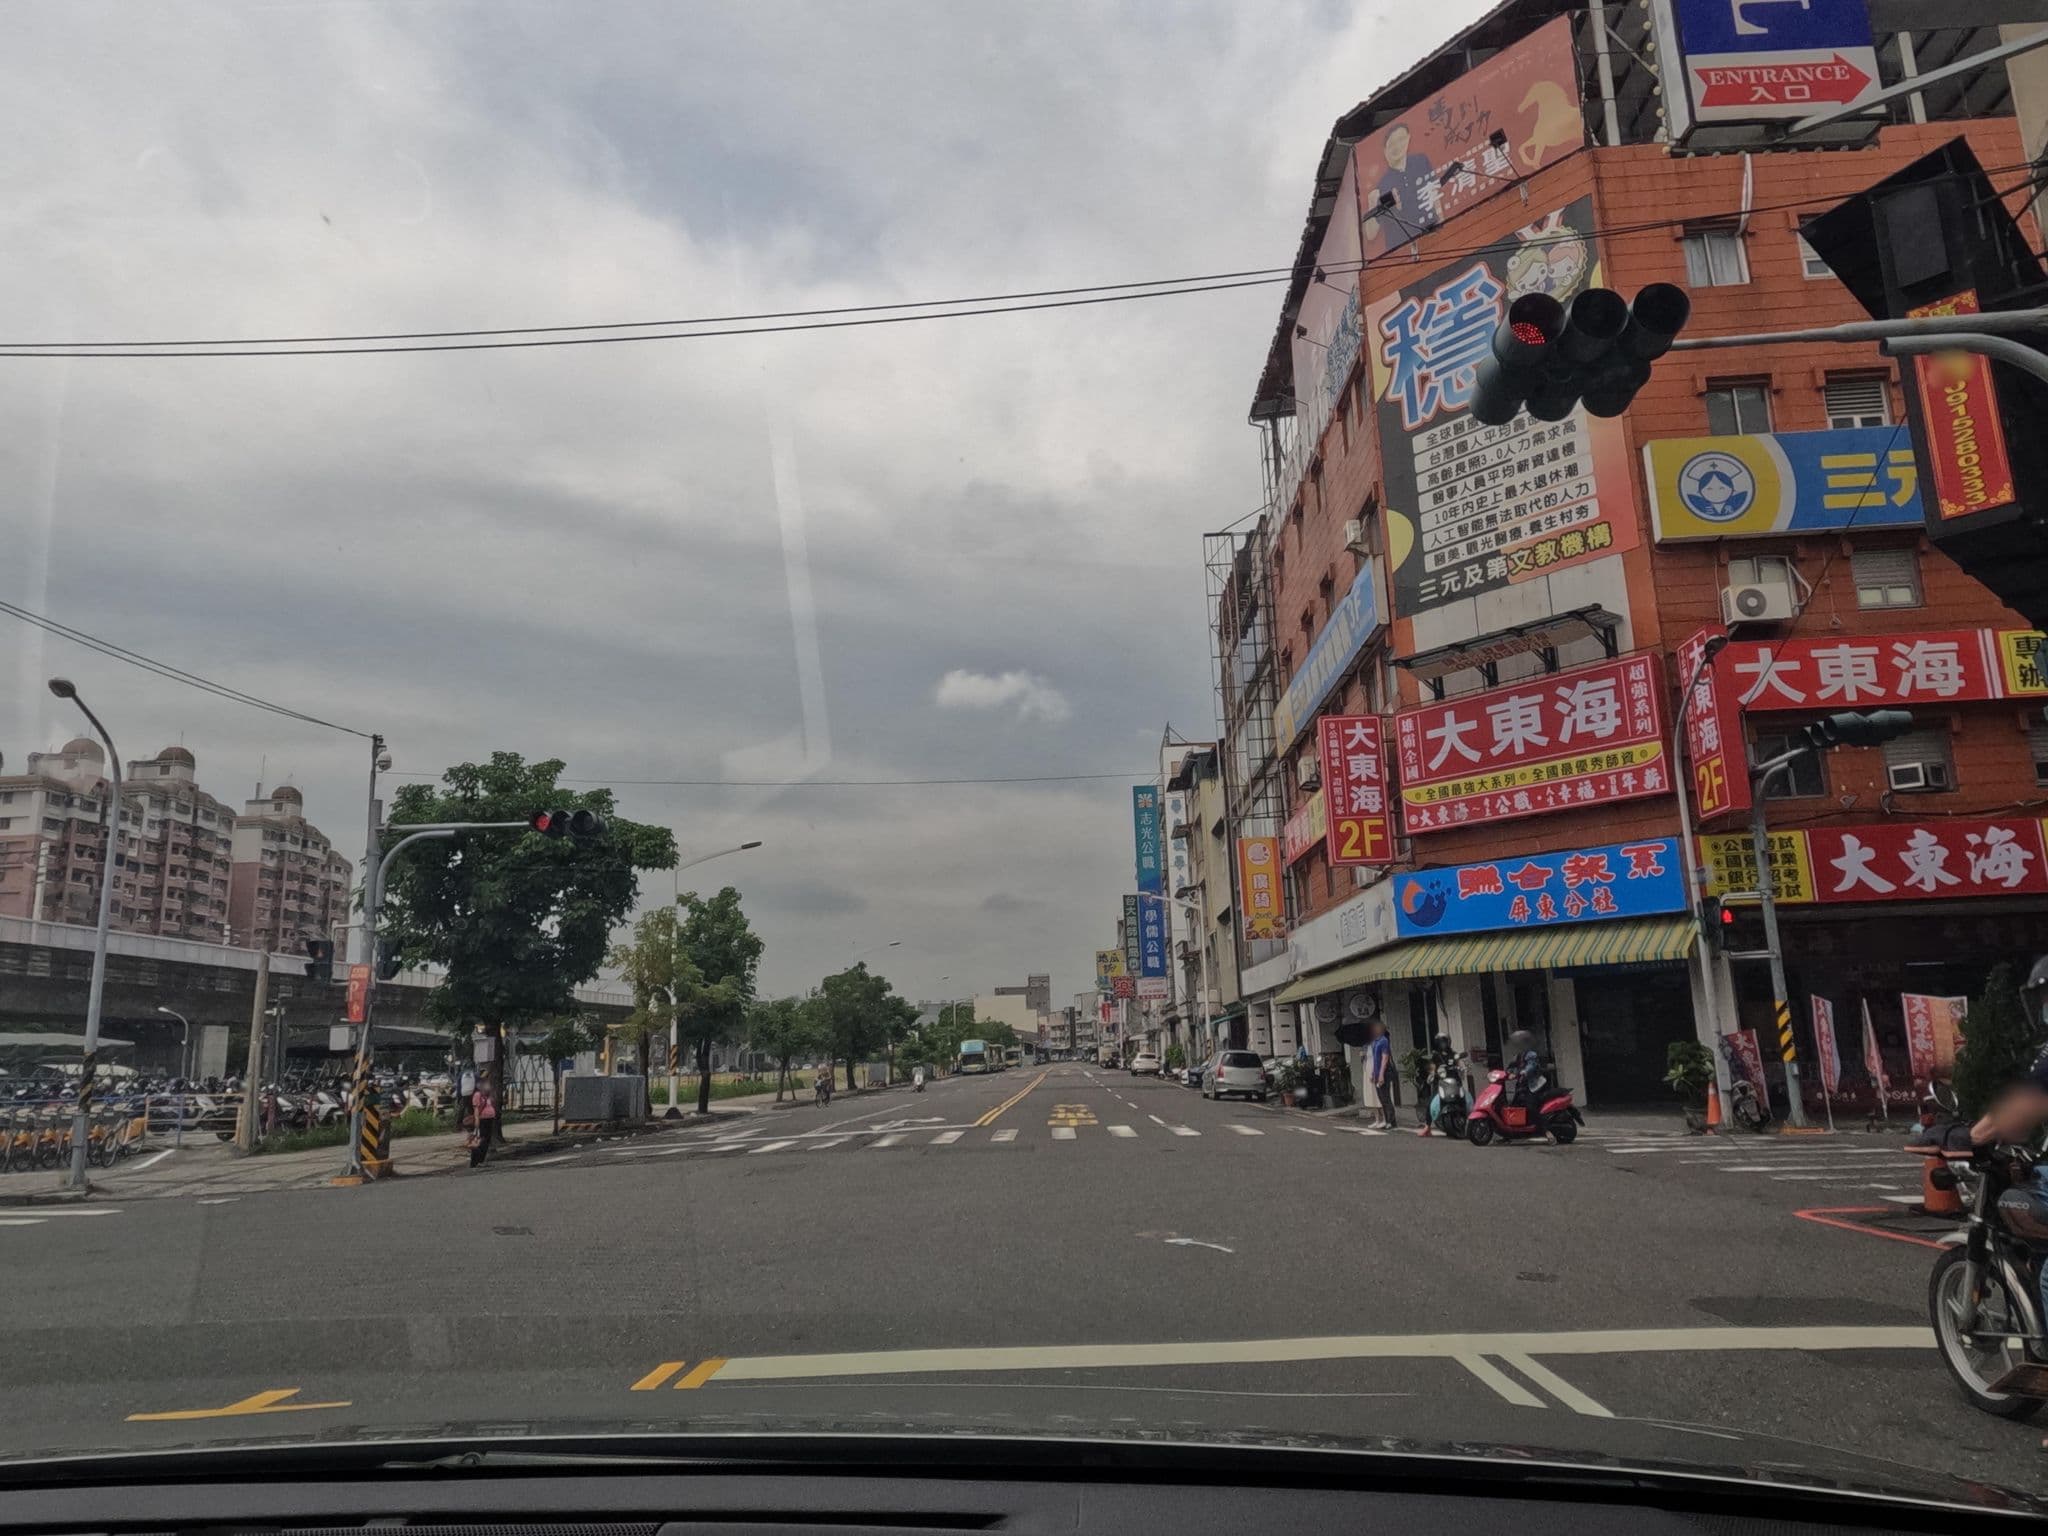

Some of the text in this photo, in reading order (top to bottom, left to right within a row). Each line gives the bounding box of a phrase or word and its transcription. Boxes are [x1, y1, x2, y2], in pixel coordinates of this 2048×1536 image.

[1708, 64, 1850, 86] ENTRANCE
[1749, 85, 1812, 102] 入口
[1380, 263, 1505, 430] 穩
[1431, 481, 1590, 547] 人工智能無法取代的人力
[1629, 664, 1653, 735] 超強系列
[1734, 640, 1966, 705] 大東海
[1425, 678, 1622, 772] 大東海
[1344, 722, 1384, 815] 大東海
[1425, 750, 1638, 801] 全國最強大系列 全國最優秀師資
[1699, 758, 1723, 811] 2F
[1140, 811, 1156, 870] 志光公職
[1338, 819, 1385, 858] 2F
[1830, 826, 2035, 895] 大東海
[1507, 888, 1618, 925] 屏東分社
[1144, 909, 1161, 969] 學儒公職
